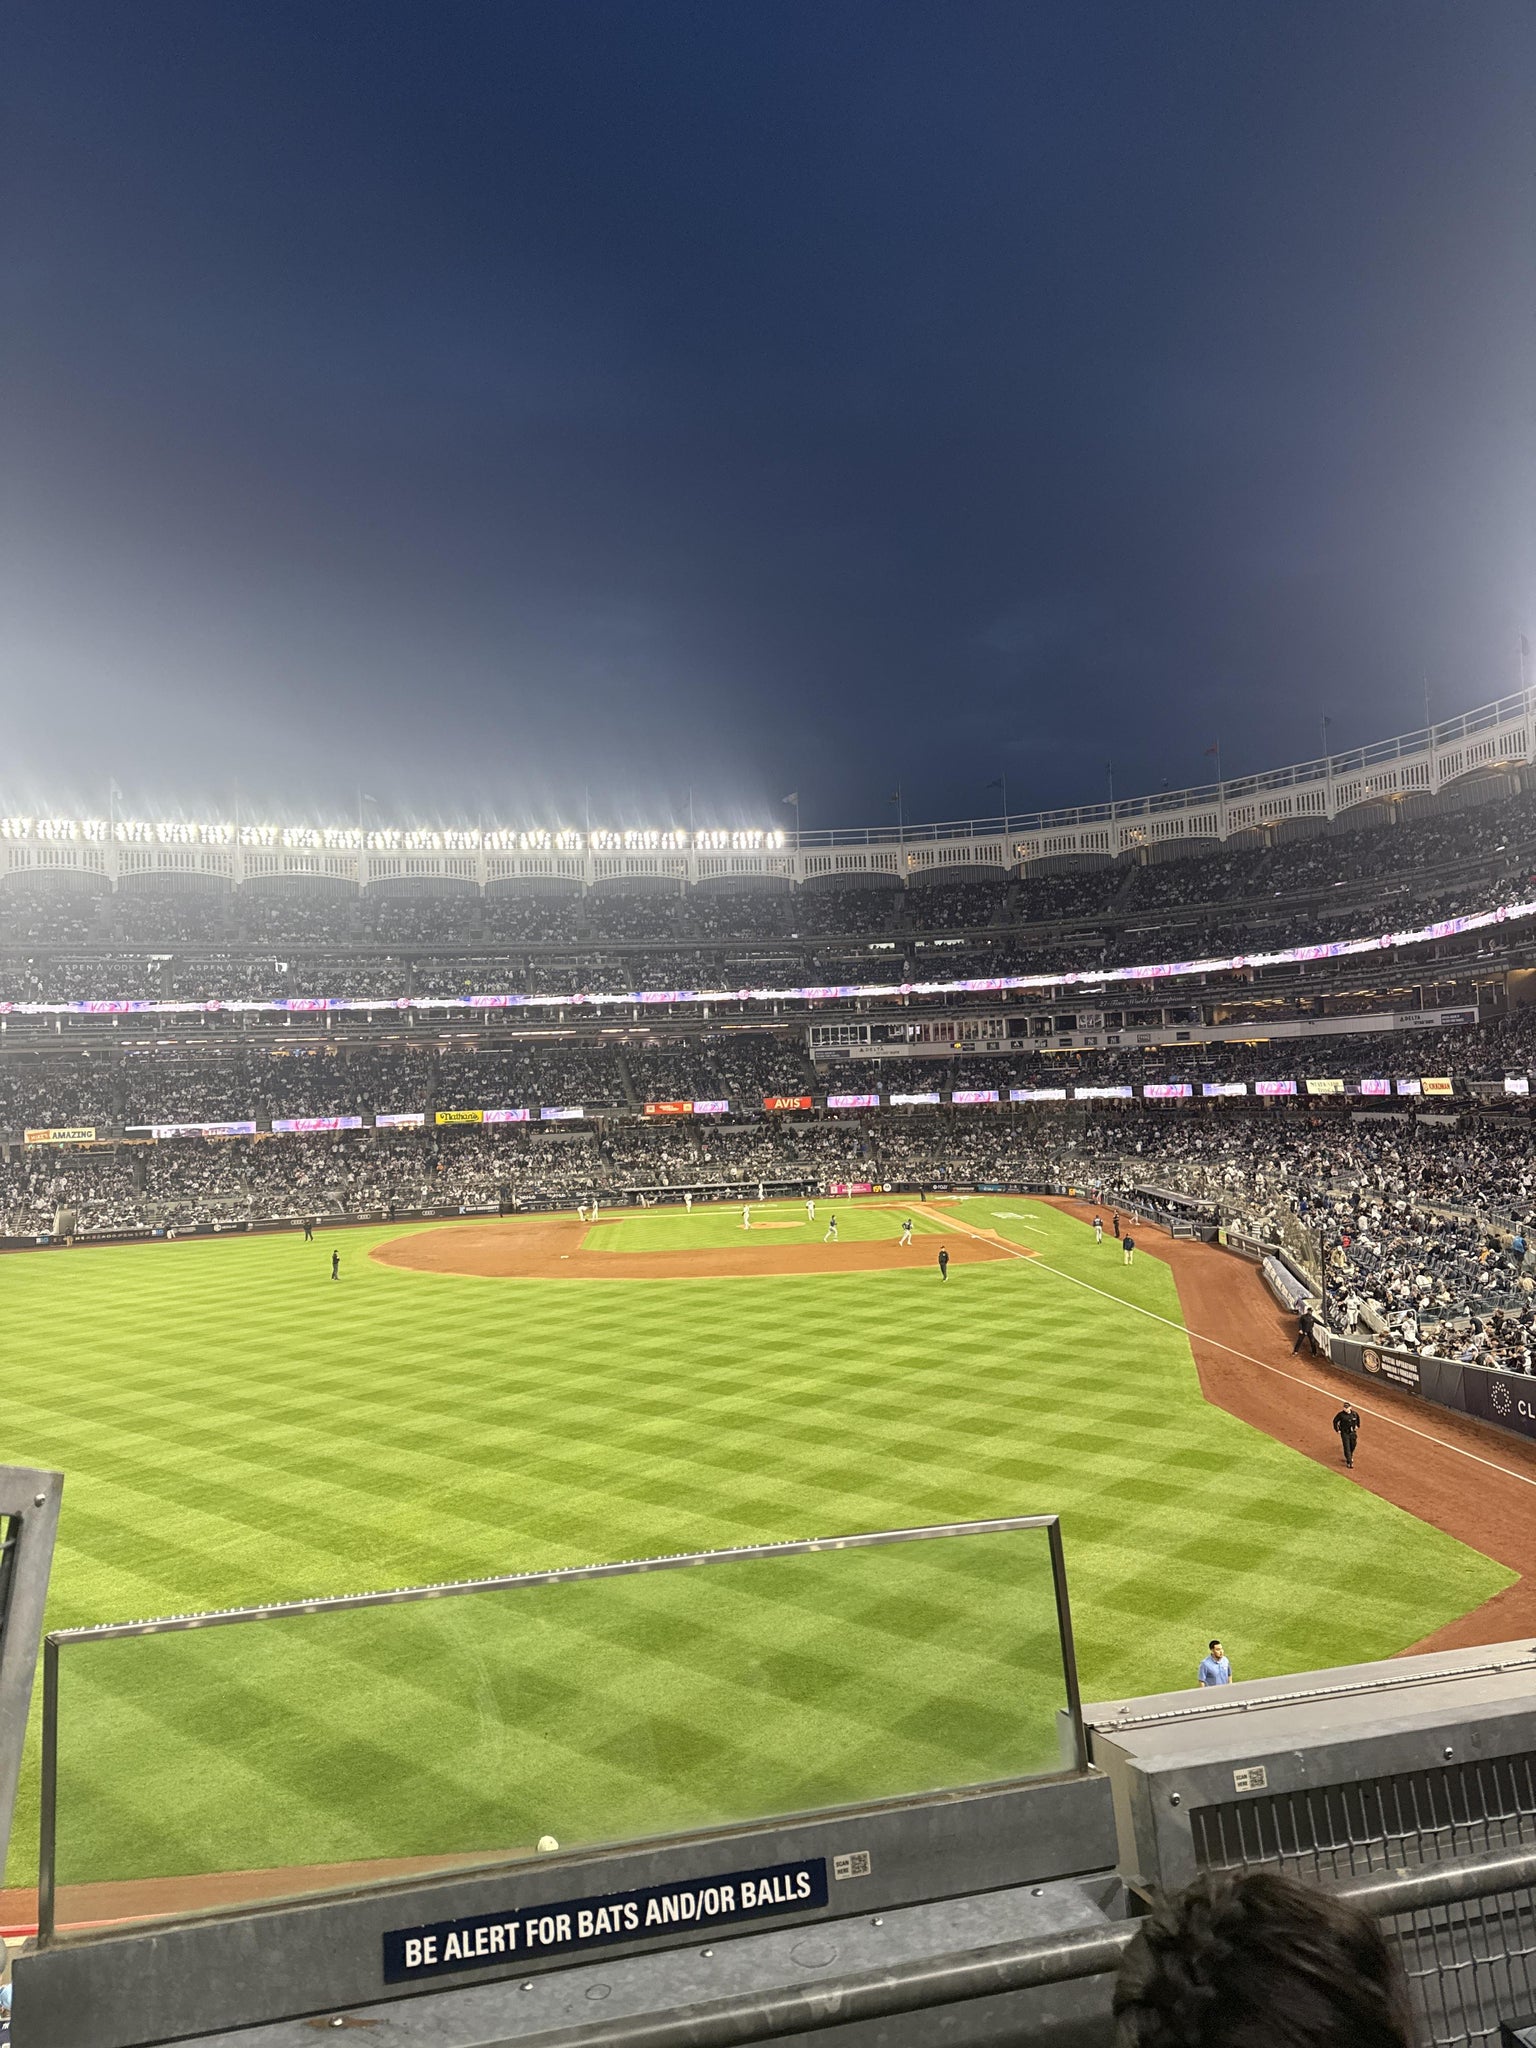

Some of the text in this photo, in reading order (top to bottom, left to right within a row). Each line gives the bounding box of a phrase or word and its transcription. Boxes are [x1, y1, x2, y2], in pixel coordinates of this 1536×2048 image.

[56, 963, 93, 972] ASPEN
[189, 964, 227, 972] ASPEN
[774, 1098, 801, 1109] AVIS
[440, 1112, 479, 1121] Nathan's
[52, 1130, 93, 1140] AMAZING
[405, 1872, 811, 1968] BE ALERT FOR BATS AND/OR BALLS
